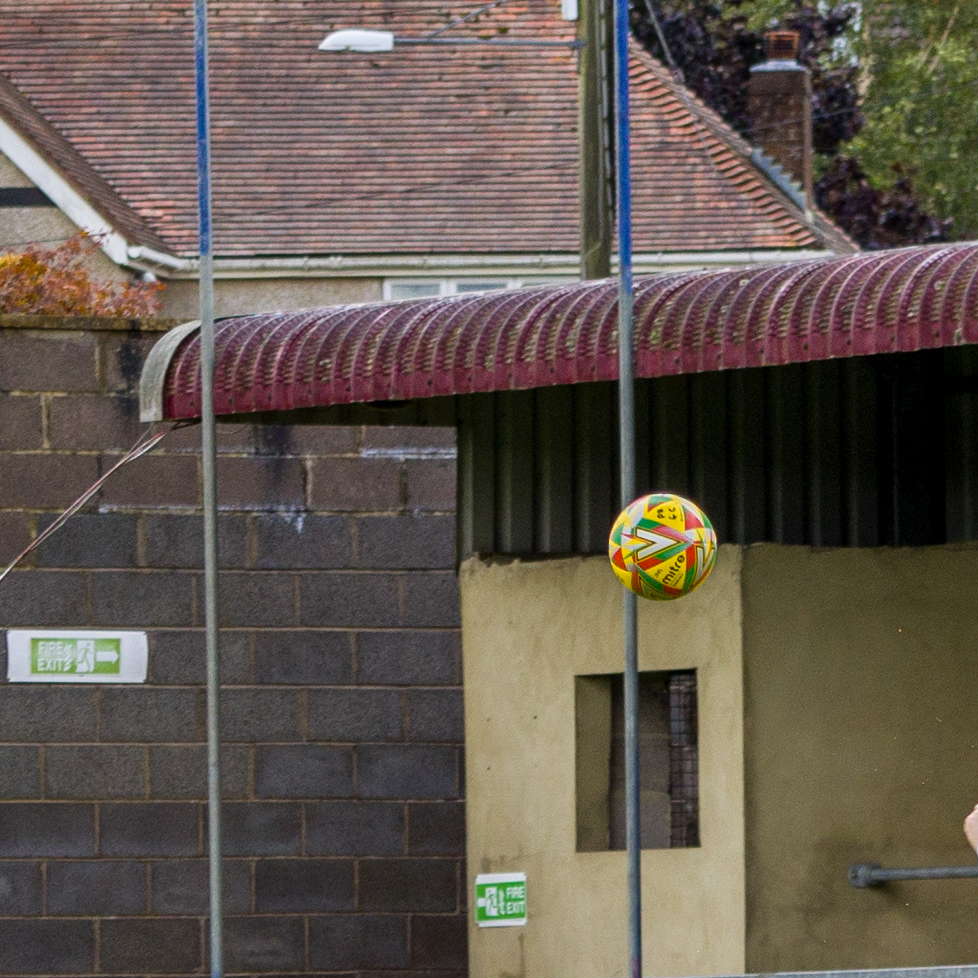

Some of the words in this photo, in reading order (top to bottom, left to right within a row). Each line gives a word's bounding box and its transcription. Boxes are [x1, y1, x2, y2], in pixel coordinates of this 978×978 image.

[662, 554, 686, 586] mitre
[37, 641, 63, 657] FIRE
[37, 658, 64, 672] EXIT
